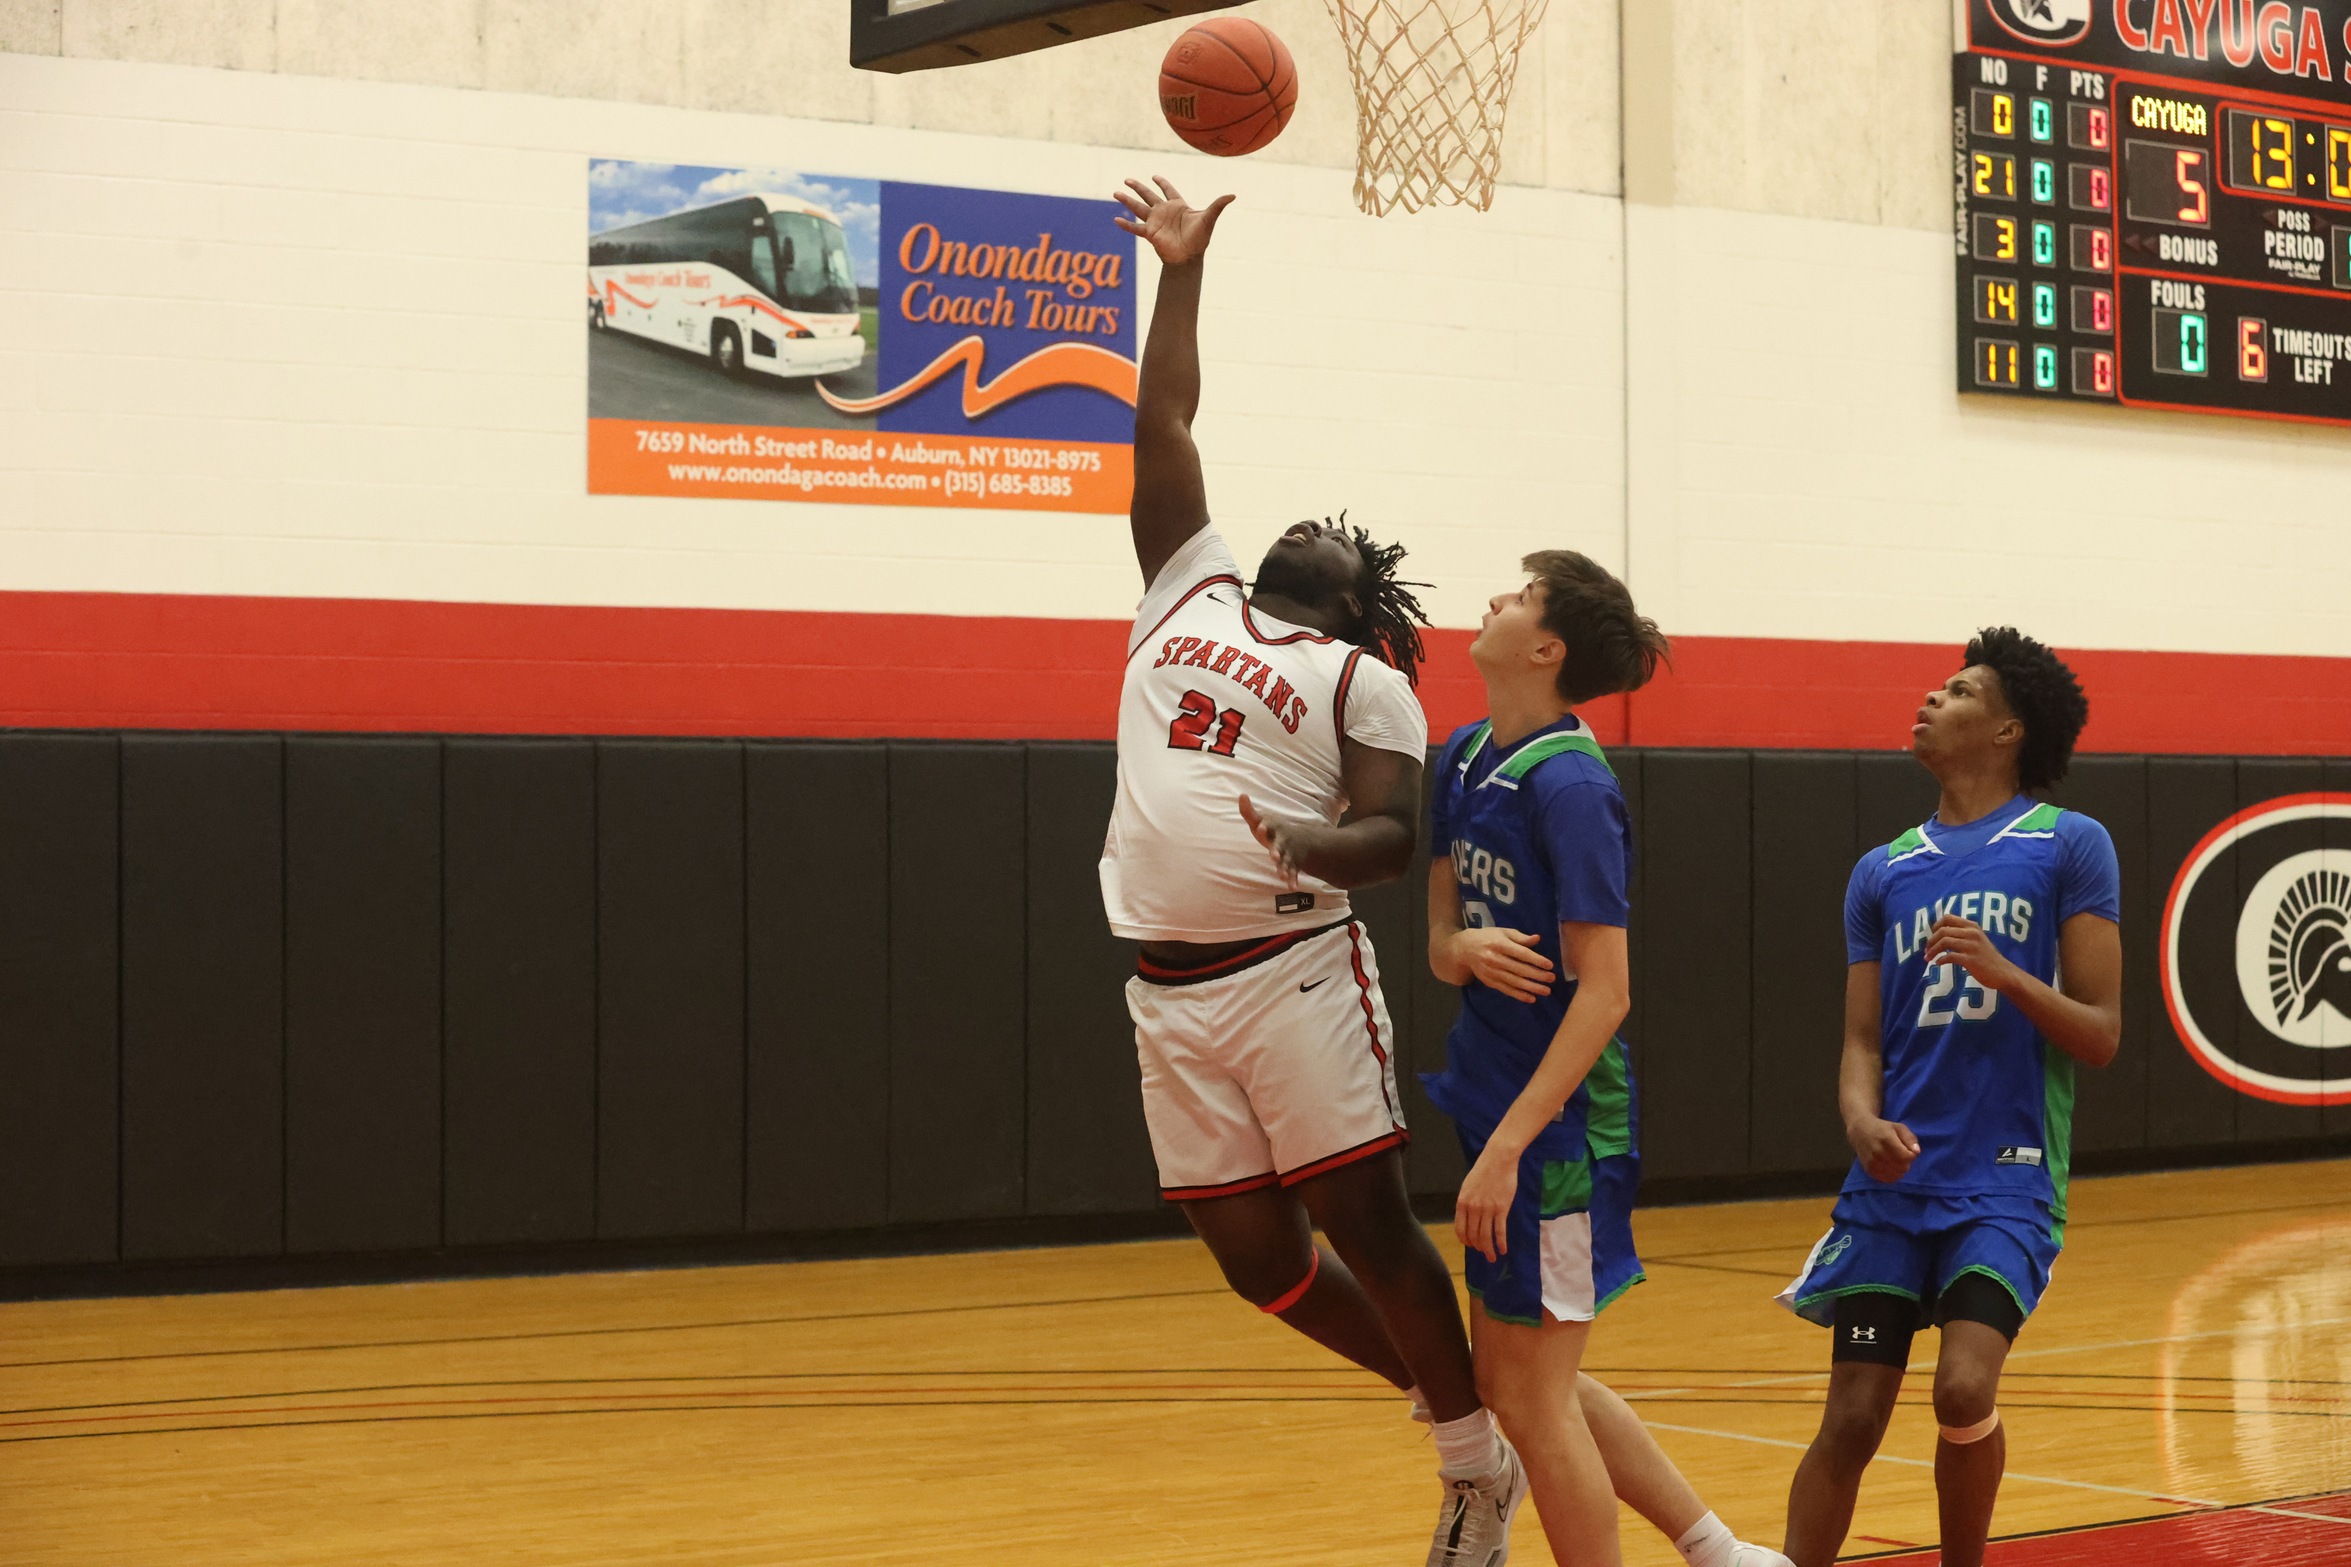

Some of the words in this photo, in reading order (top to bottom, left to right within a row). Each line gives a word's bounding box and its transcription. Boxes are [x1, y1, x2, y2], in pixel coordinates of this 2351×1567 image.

[2113, 0, 2333, 82] CAYUGA
[1980, 58, 2008, 86] NO
[2036, 66, 2048, 90] F
[2070, 70, 2105, 99] PTS
[1993, 94, 2012, 135] 0
[2031, 100, 2051, 141] 0
[2089, 108, 2107, 148] 0
[2131, 95, 2207, 136] CAYUGA
[1974, 153, 2014, 196] 21
[2033, 161, 2052, 202] 0
[2090, 169, 2108, 208] 0
[2176, 150, 2207, 222] 5
[1996, 219, 2015, 259] 3
[2034, 224, 2053, 264] 0
[2091, 230, 2109, 270] 0
[2278, 208, 2311, 232] POSS
[899, 222, 1122, 299] Onondaga
[2159, 234, 2218, 266] BONUS
[2264, 229, 2325, 262] PERIOD
[901, 280, 1014, 327] Coach
[1025, 289, 1119, 335] Tours
[1987, 281, 2016, 321] 14
[2035, 285, 2054, 326] 0
[2093, 291, 2111, 331] 0
[2150, 280, 2206, 310] FOULS
[2180, 314, 2205, 372] 0
[2241, 320, 2265, 378] 6
[2272, 327, 2351, 361] TIMEOUTS
[1988, 344, 2016, 382] 11
[2035, 347, 2055, 388] 0
[2093, 352, 2112, 393] 0
[2294, 356, 2333, 385] LEFT
[635, 430, 684, 451] 7659
[688, 433, 750, 456] North
[754, 436, 818, 458] Street
[822, 439, 873, 461] Road
[890, 441, 965, 468] Auburn,
[969, 446, 999, 467] NY
[1003, 448, 1101, 472] 13021-8975
[668, 462, 927, 492] www.onondagacoach.com
[944, 469, 985, 499] (315)
[989, 473, 1072, 497] 685-8385
[1153, 636, 1308, 734] SPARTANS
[1167, 689, 1246, 758] 21
